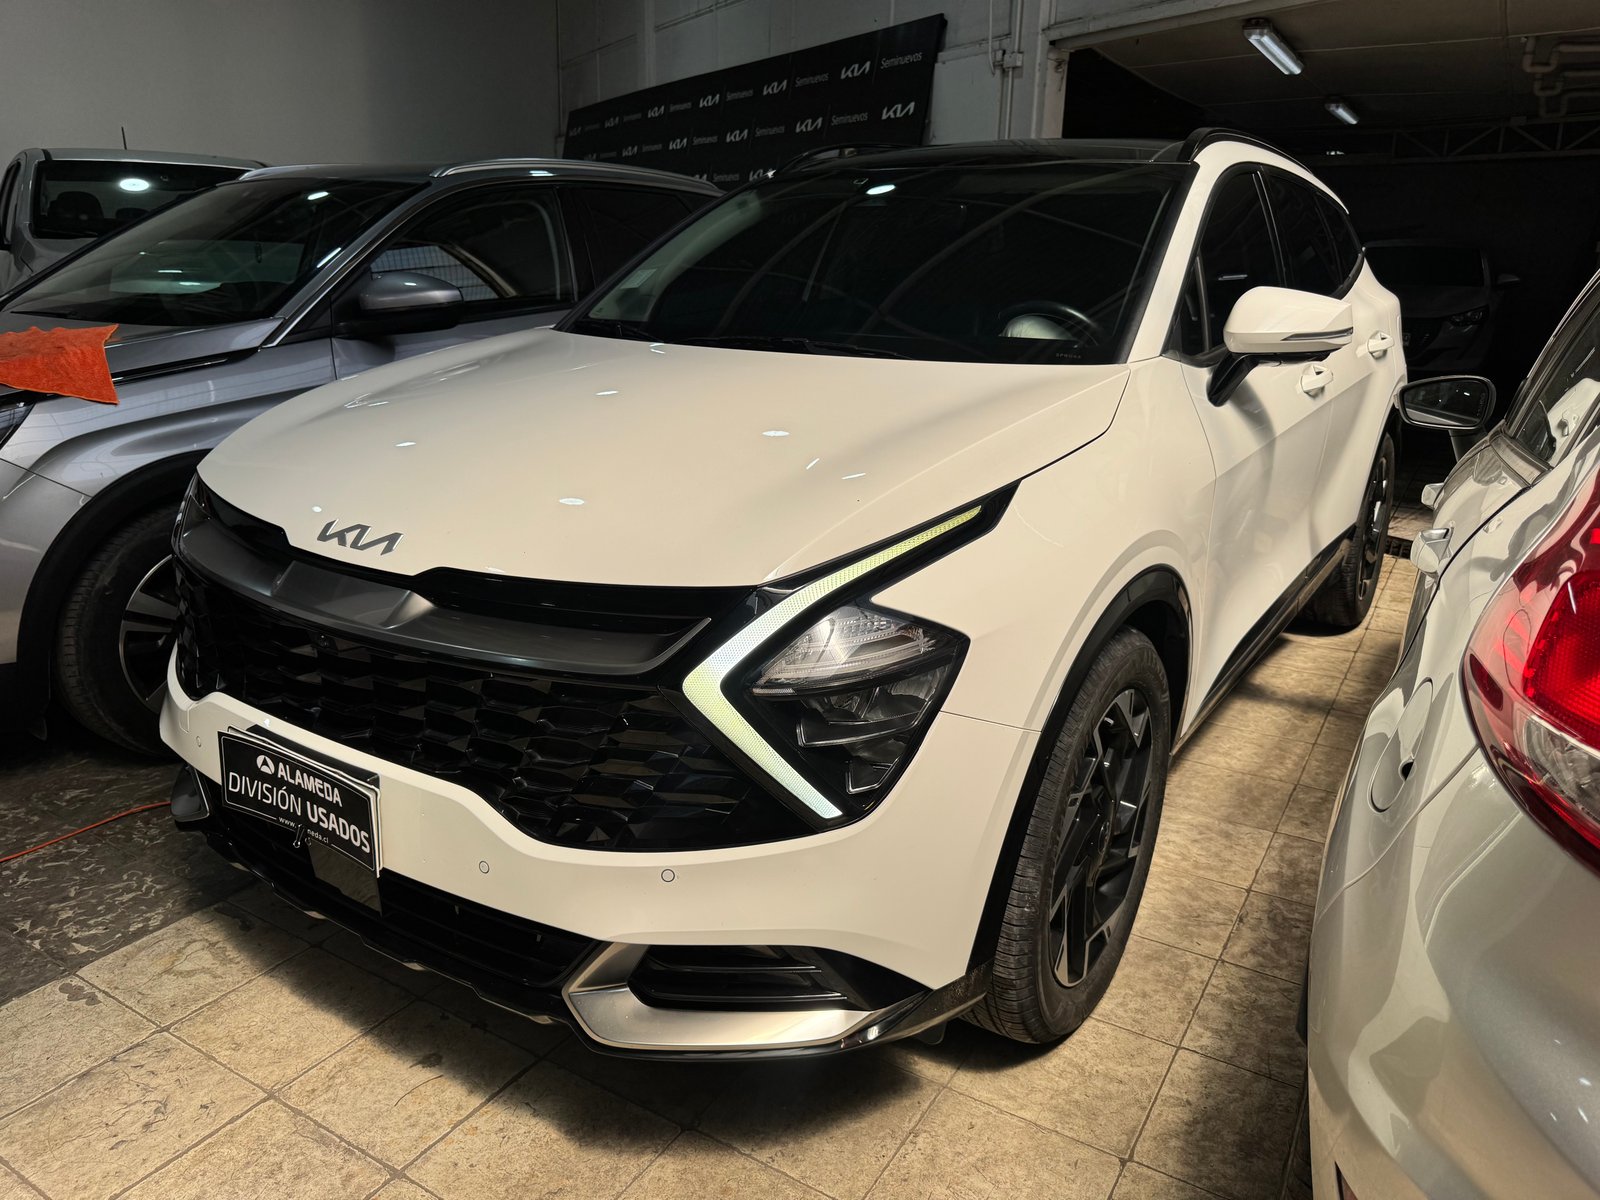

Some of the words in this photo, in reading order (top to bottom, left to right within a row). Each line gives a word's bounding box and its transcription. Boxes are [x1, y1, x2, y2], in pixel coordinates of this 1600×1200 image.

[647, 104, 665, 118] KIA
[699, 93, 720, 108] KIA
[762, 79, 788, 96] KIA
[840, 60, 871, 80] KIA
[881, 52, 923, 69] Seminuevos
[668, 137, 688, 150] KIA
[726, 128, 749, 143] KIA
[795, 117, 823, 133] KIA
[831, 112, 868, 126] Seminuevos
[881, 101, 916, 120] KIA
[316, 518, 404, 555] KIA
[277, 762, 343, 808] ALAMEDA
[228, 771, 302, 816] DIVISIÓN
[306, 801, 371, 854] USADOS
